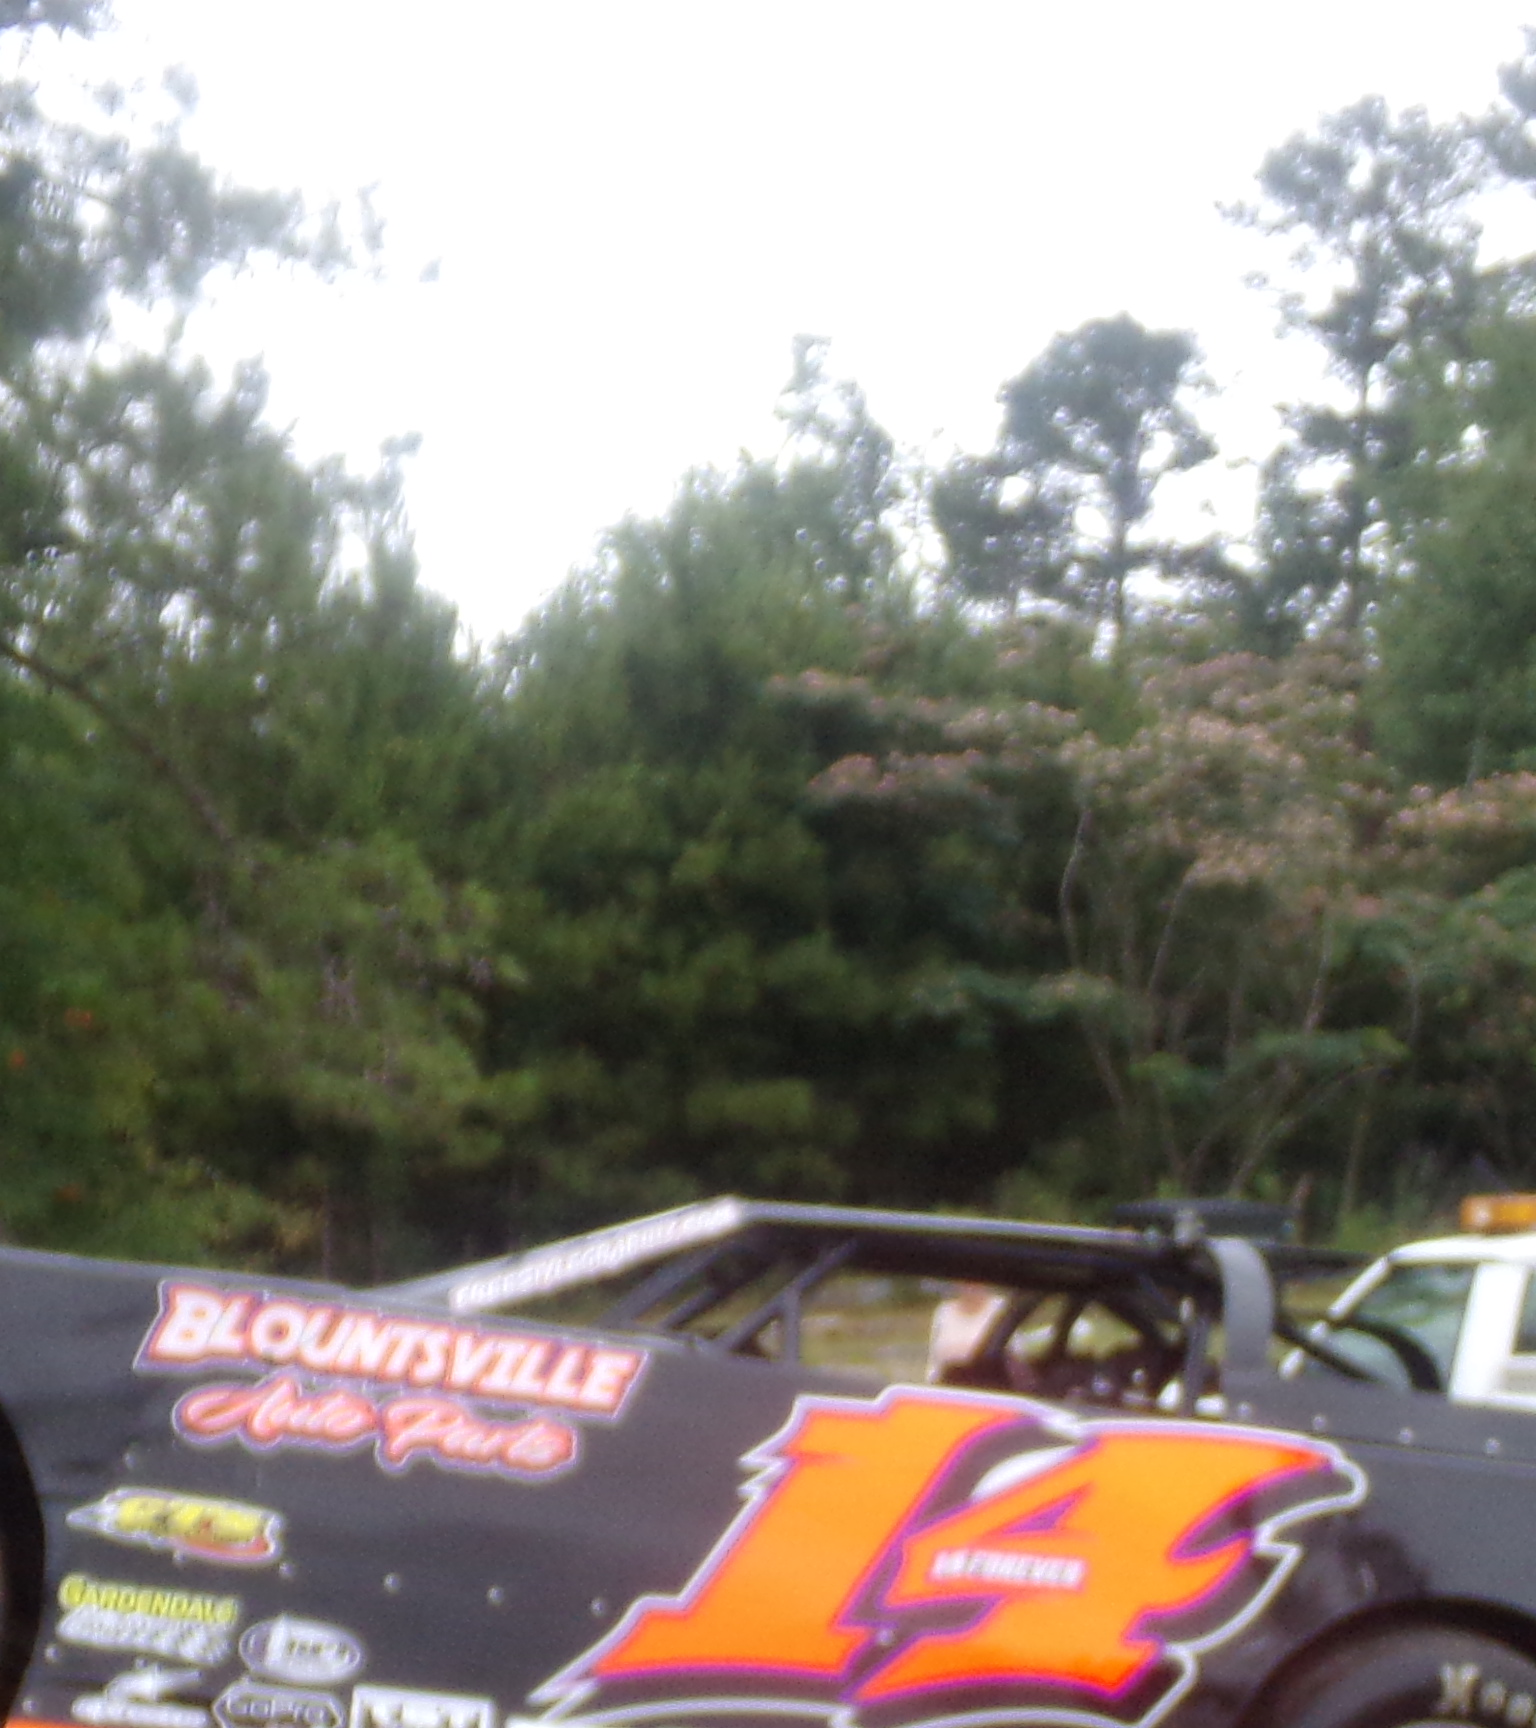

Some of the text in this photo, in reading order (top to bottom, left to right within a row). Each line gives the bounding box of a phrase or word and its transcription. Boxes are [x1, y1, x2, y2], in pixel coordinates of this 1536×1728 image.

[144, 1284, 649, 1411] BLOUNTSVILLE
[176, 1376, 576, 1470] Auto Parts
[574, 1394, 1344, 1706] 14
